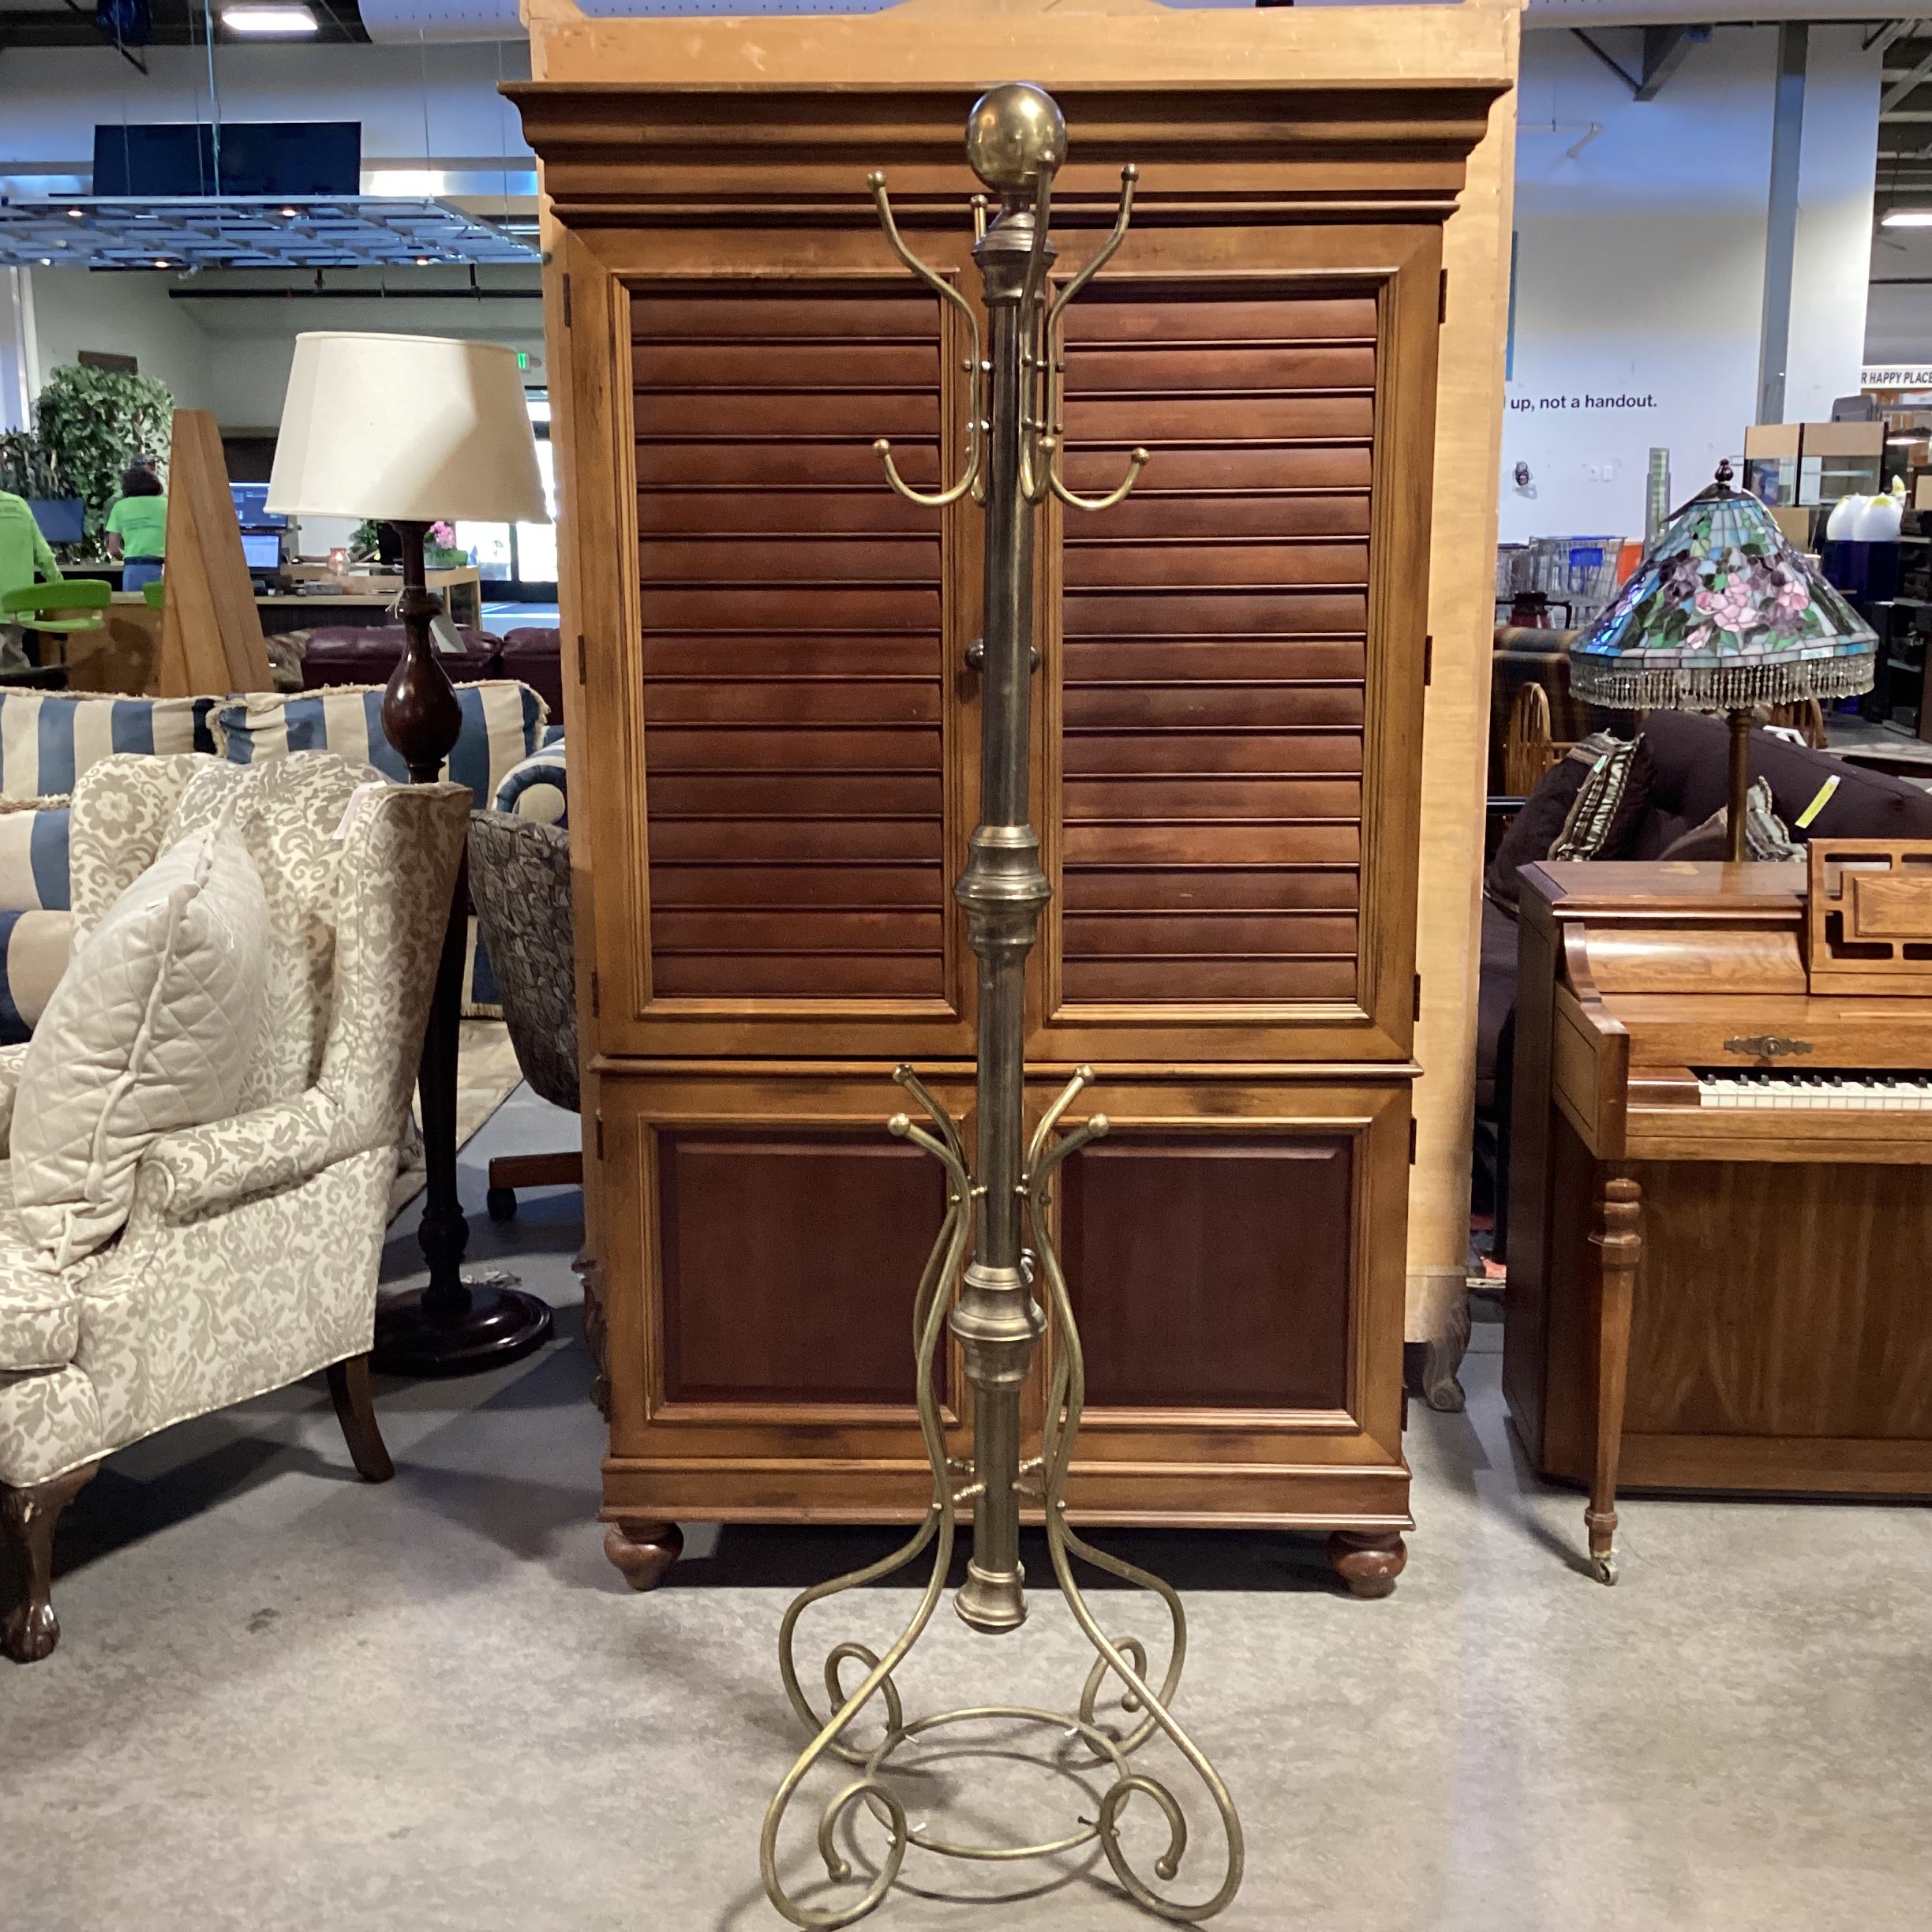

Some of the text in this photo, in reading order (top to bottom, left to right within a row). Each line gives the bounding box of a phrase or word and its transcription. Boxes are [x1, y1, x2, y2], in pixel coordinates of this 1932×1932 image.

[1869, 372, 1902, 384] HAPPY
[1511, 399, 1535, 412] up,
[1540, 395, 1567, 409] not
[1571, 399, 1580, 408] a
[1585, 394, 1657, 408] handout.
